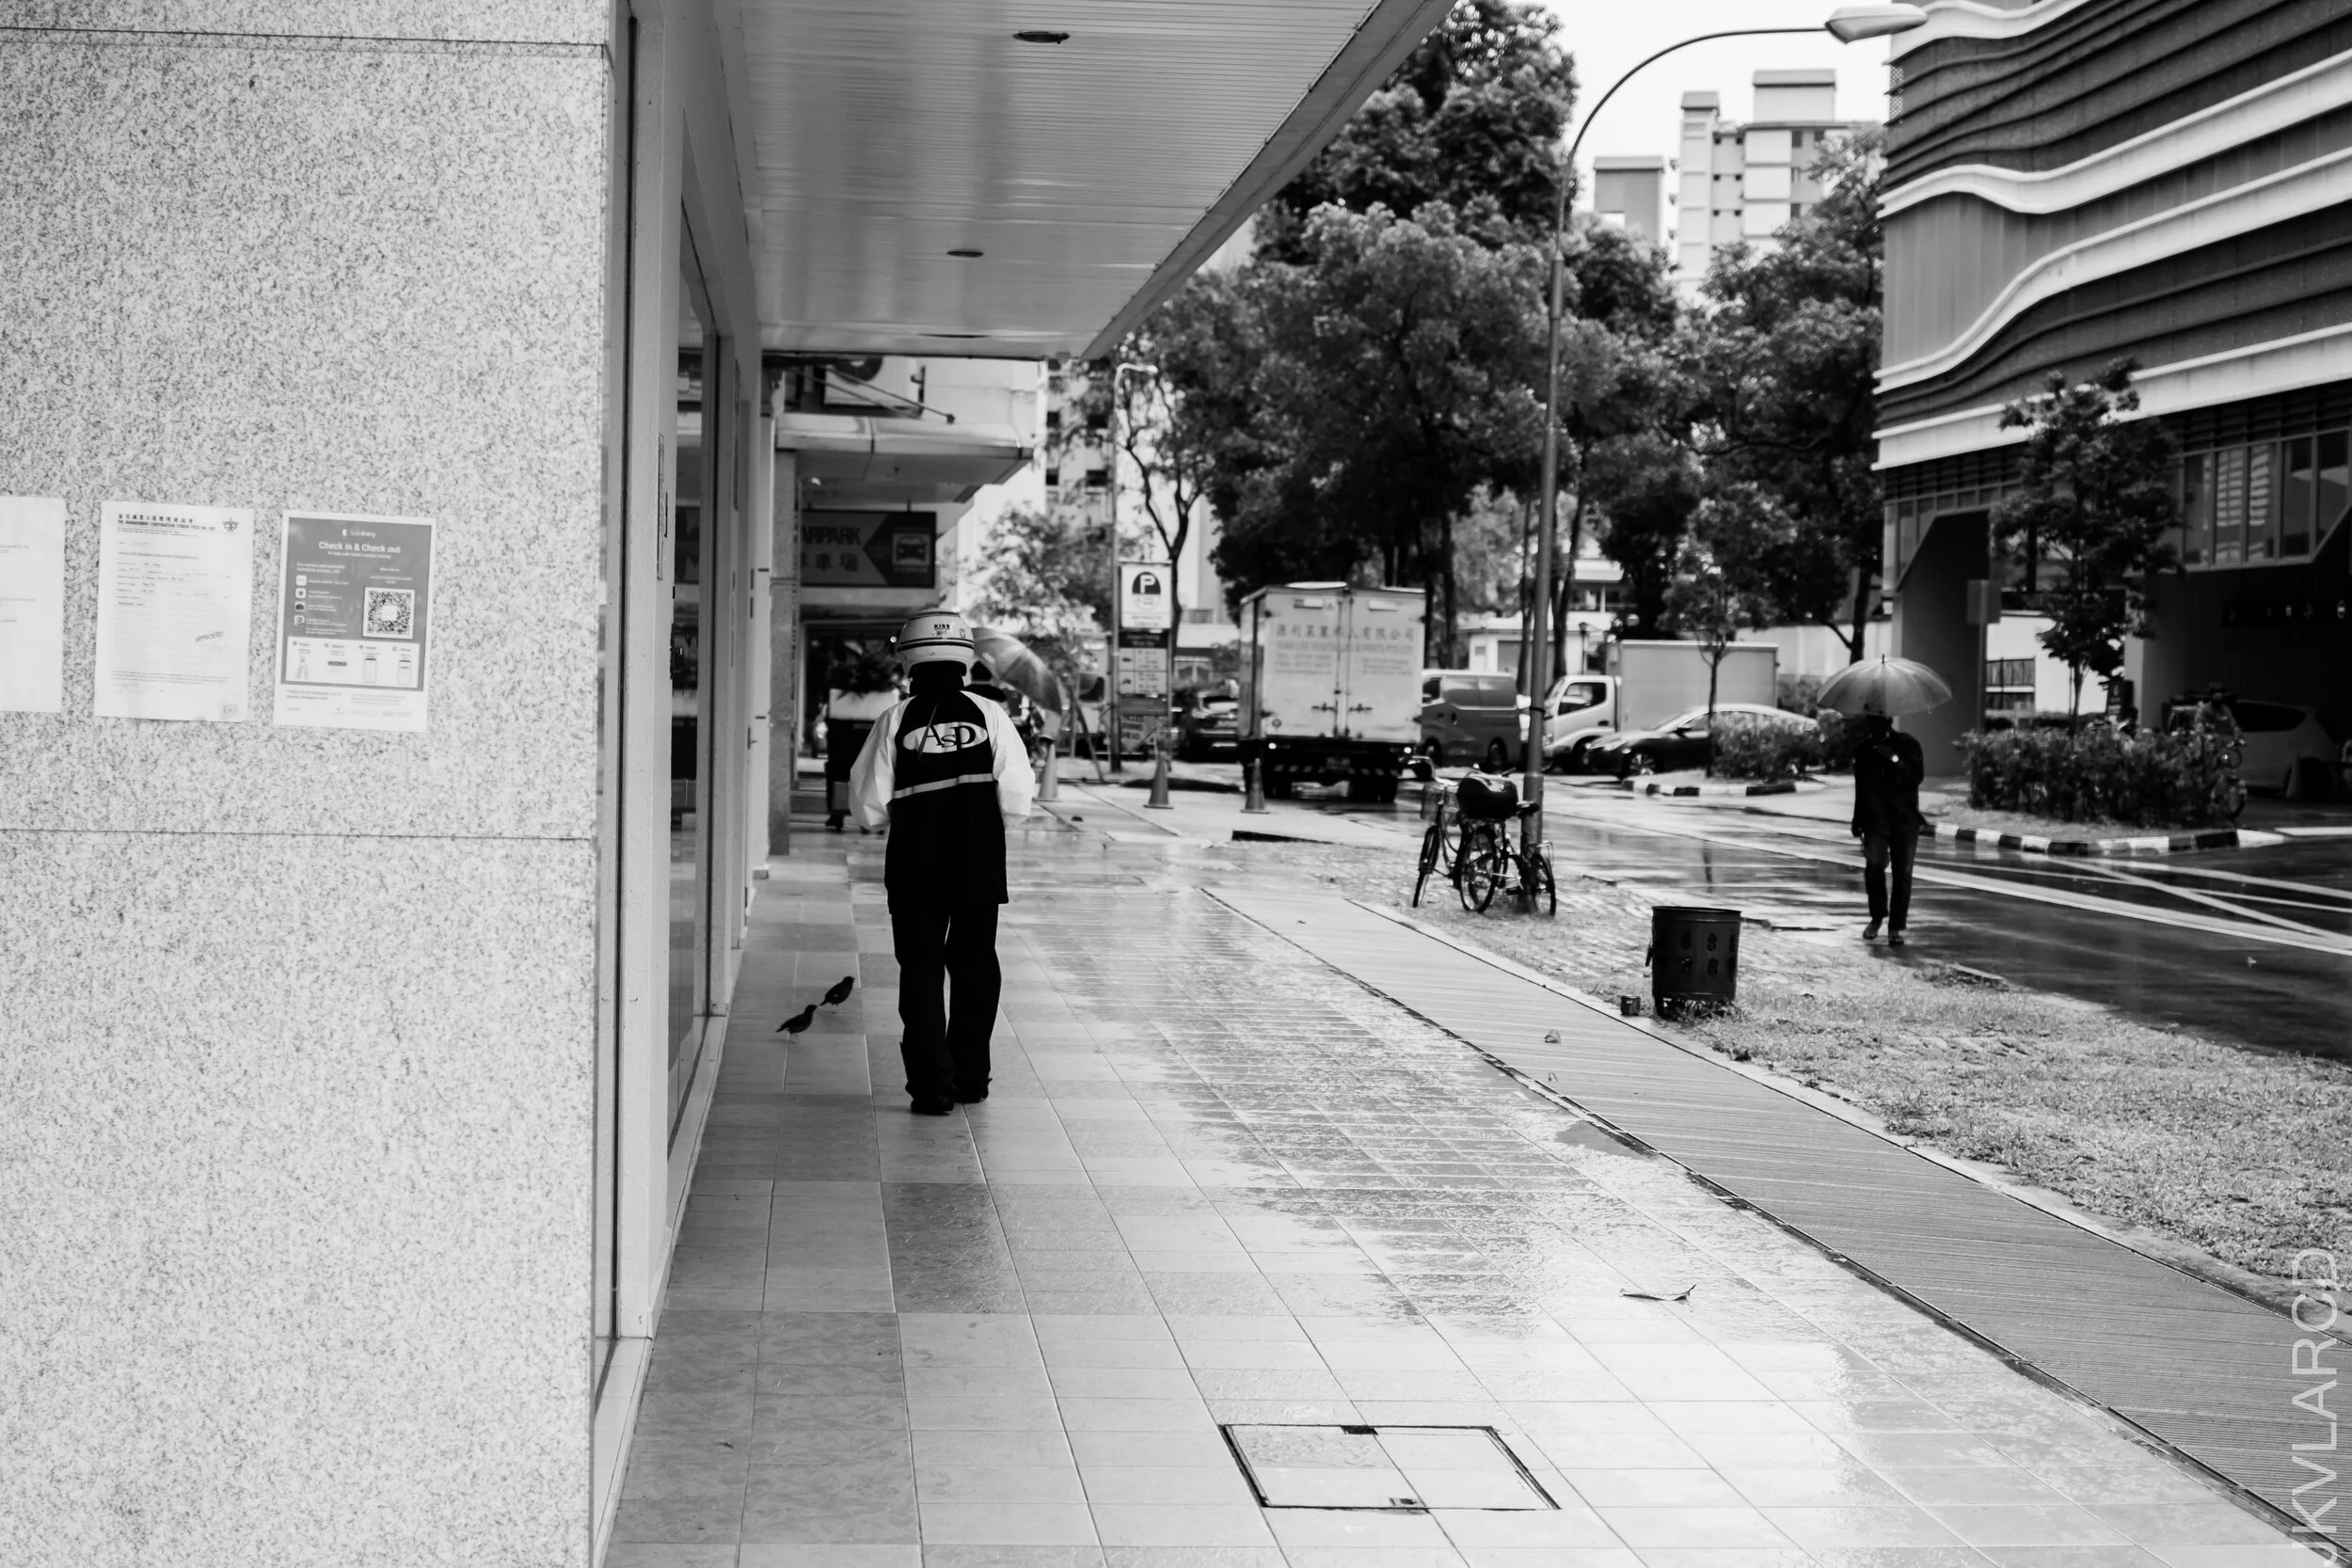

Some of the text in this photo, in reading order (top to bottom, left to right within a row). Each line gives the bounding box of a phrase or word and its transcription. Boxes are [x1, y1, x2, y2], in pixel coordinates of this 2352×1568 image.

[801, 526, 861, 546] ARPARK
[318, 541, 401, 554] Check in & Check out
[1139, 574, 1156, 594] P
[916, 722, 977, 752] ASD
